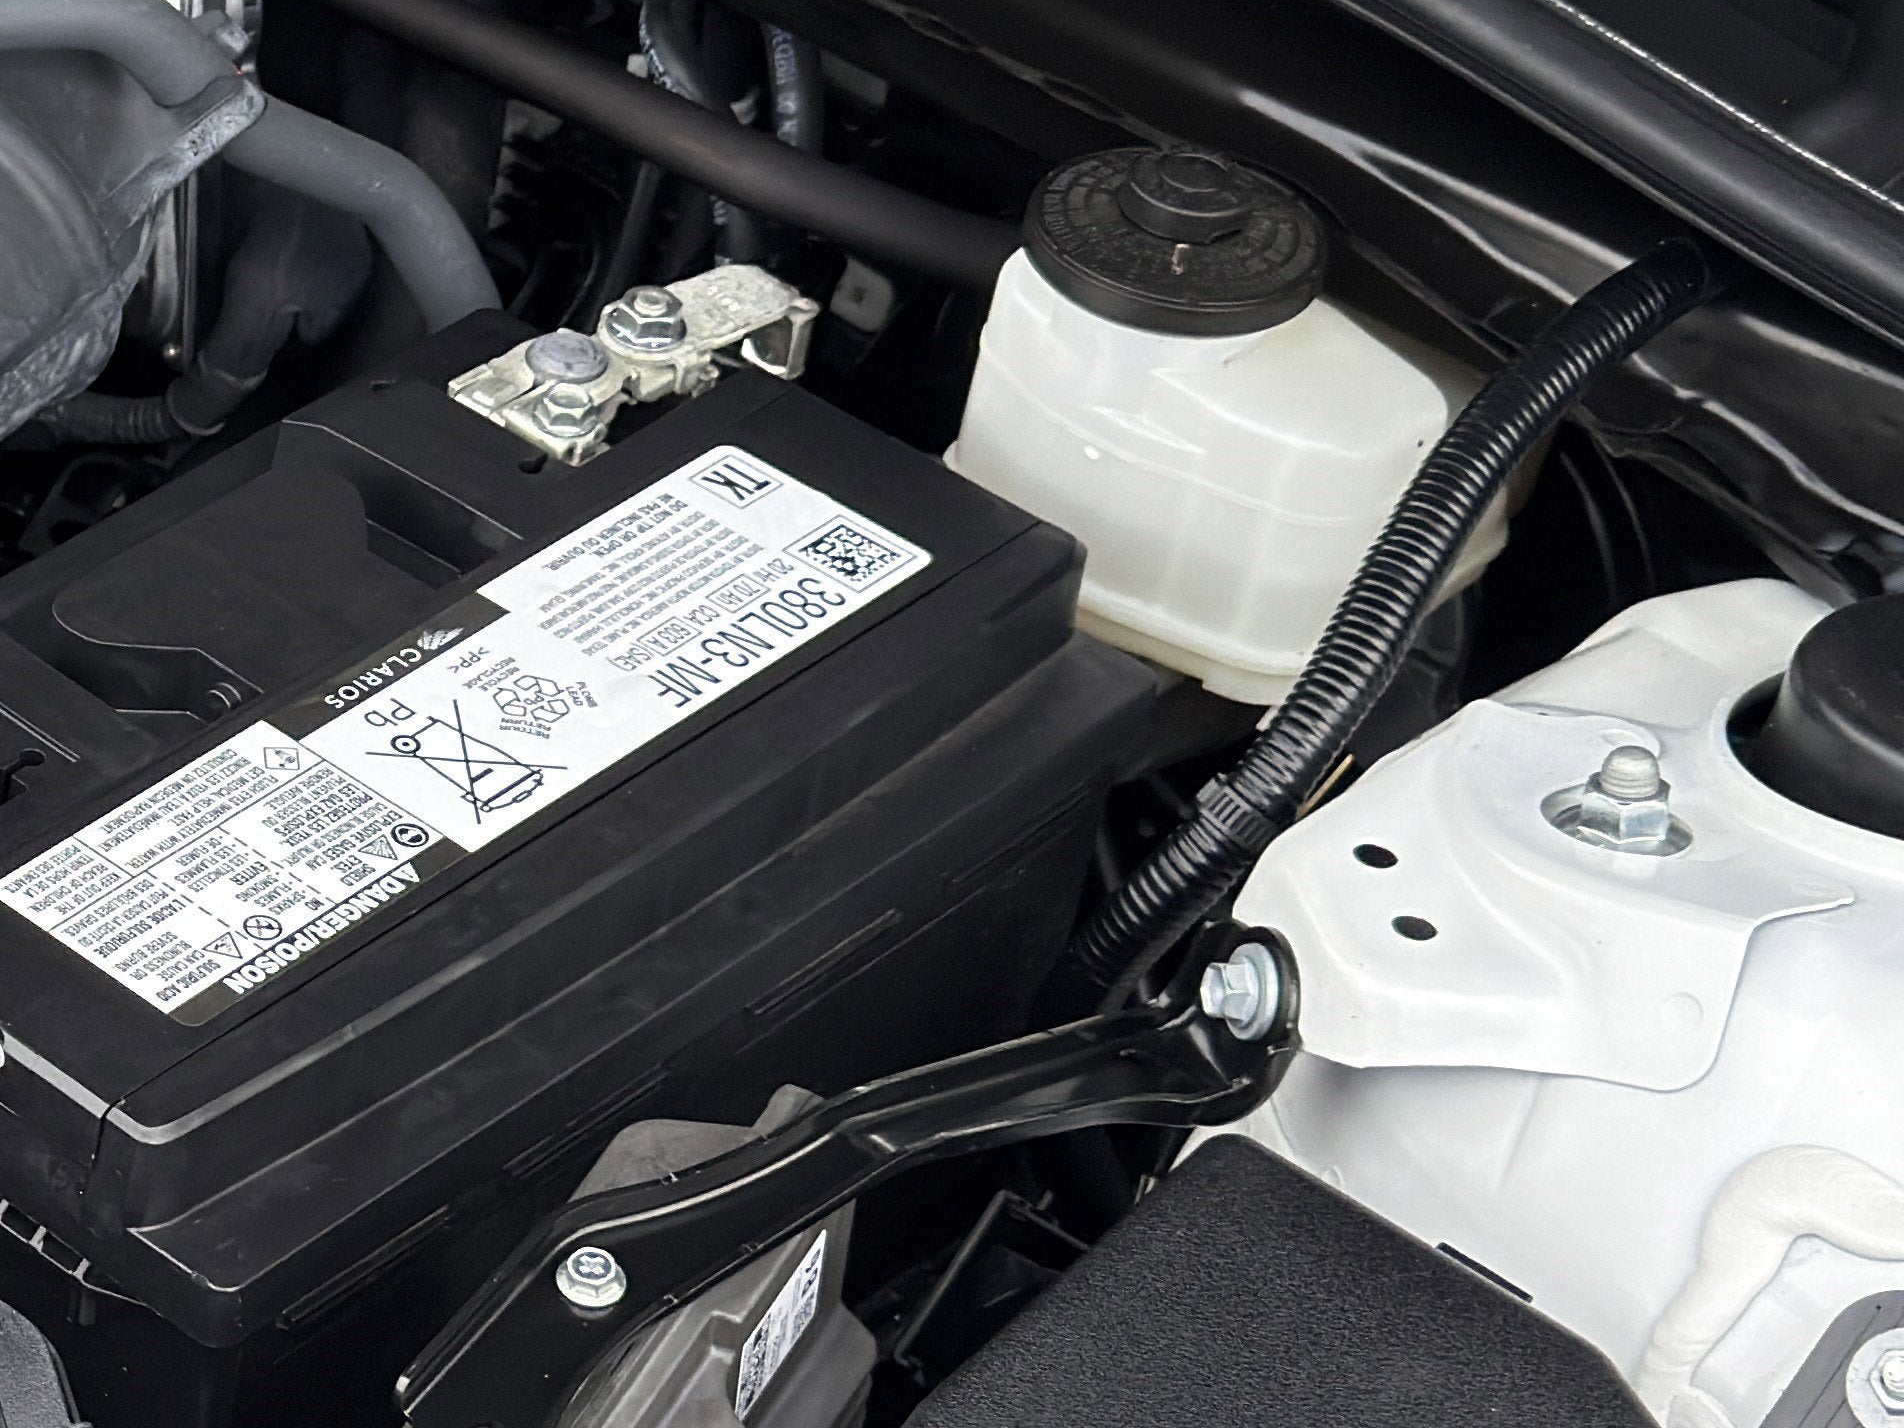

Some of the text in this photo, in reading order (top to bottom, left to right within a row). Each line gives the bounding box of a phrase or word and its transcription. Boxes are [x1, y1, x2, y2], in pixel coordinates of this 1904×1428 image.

[700, 463, 773, 502] TK
[636, 500, 662, 517] PAS
[648, 508, 674, 525] NOT
[667, 499, 689, 513] DO
[617, 529, 639, 543] OR
[635, 520, 656, 535] TIP
[765, 556, 796, 576] 20
[714, 588, 745, 606] Ah
[731, 579, 762, 598] 70
[681, 603, 722, 627] CCA
[644, 635, 670, 651] A
[646, 576, 847, 709] 380LN3-MF
[656, 622, 693, 645] 603
[445, 646, 491, 675] >PP<
[605, 641, 655, 673] (SAE)
[323, 647, 423, 710] CLARIOS
[461, 656, 517, 690] RECYCLAGE
[476, 665, 522, 693] RECYCLE
[363, 697, 418, 728] Pb
[190, 747, 239, 779] CONSULTEZ
[244, 765, 266, 781] GET
[204, 772, 226, 787] LES
[208, 775, 251, 800] MEDICAL
[246, 773, 280, 796] FLUSH
[297, 766, 336, 791] RENDRE
[306, 774, 348, 802] PEUVENT
[190, 795, 217, 815] HELP
[272, 795, 313, 822] BLESSER
[272, 782, 362, 838] LES GAZ EXPLOSIFS
[358, 801, 389, 822] CAUSE
[176, 801, 234, 840] IMMEDIATELY
[306, 817, 332, 834] LES
[319, 814, 366, 844] BLINDNESS
[153, 834, 183, 853] WITH
[174, 836, 223, 868] DE FUMER
[304, 809, 405, 872] EXPLOSIVE GASES CAN
[308, 837, 327, 850] OR
[33, 859, 56, 876] DES
[77, 862, 110, 884] REACH
[173, 844, 237, 885] LES FLAMMES
[227, 853, 250, 868] LES
[21, 853, 96, 899] TENIR HORS DE LA
[68, 877, 85, 891] OF
[132, 878, 156, 894] DES
[228, 860, 271, 887] ÉVITER
[339, 862, 377, 888] SHIELD
[53, 871, 123, 916] KEEP OUT OF THE
[146, 887, 170, 906] PEUT
[303, 896, 326, 912] NO
[92, 898, 187, 960] L'ACIDE SULFURIQUE
[222, 874, 407, 995] DANGER/POISON
[141, 930, 179, 955] SEVERE
[128, 939, 193, 982] BLINDNESS OR
[155, 948, 206, 983] CAN CAUSE
[154, 958, 222, 1003] SULFURIC ACID
